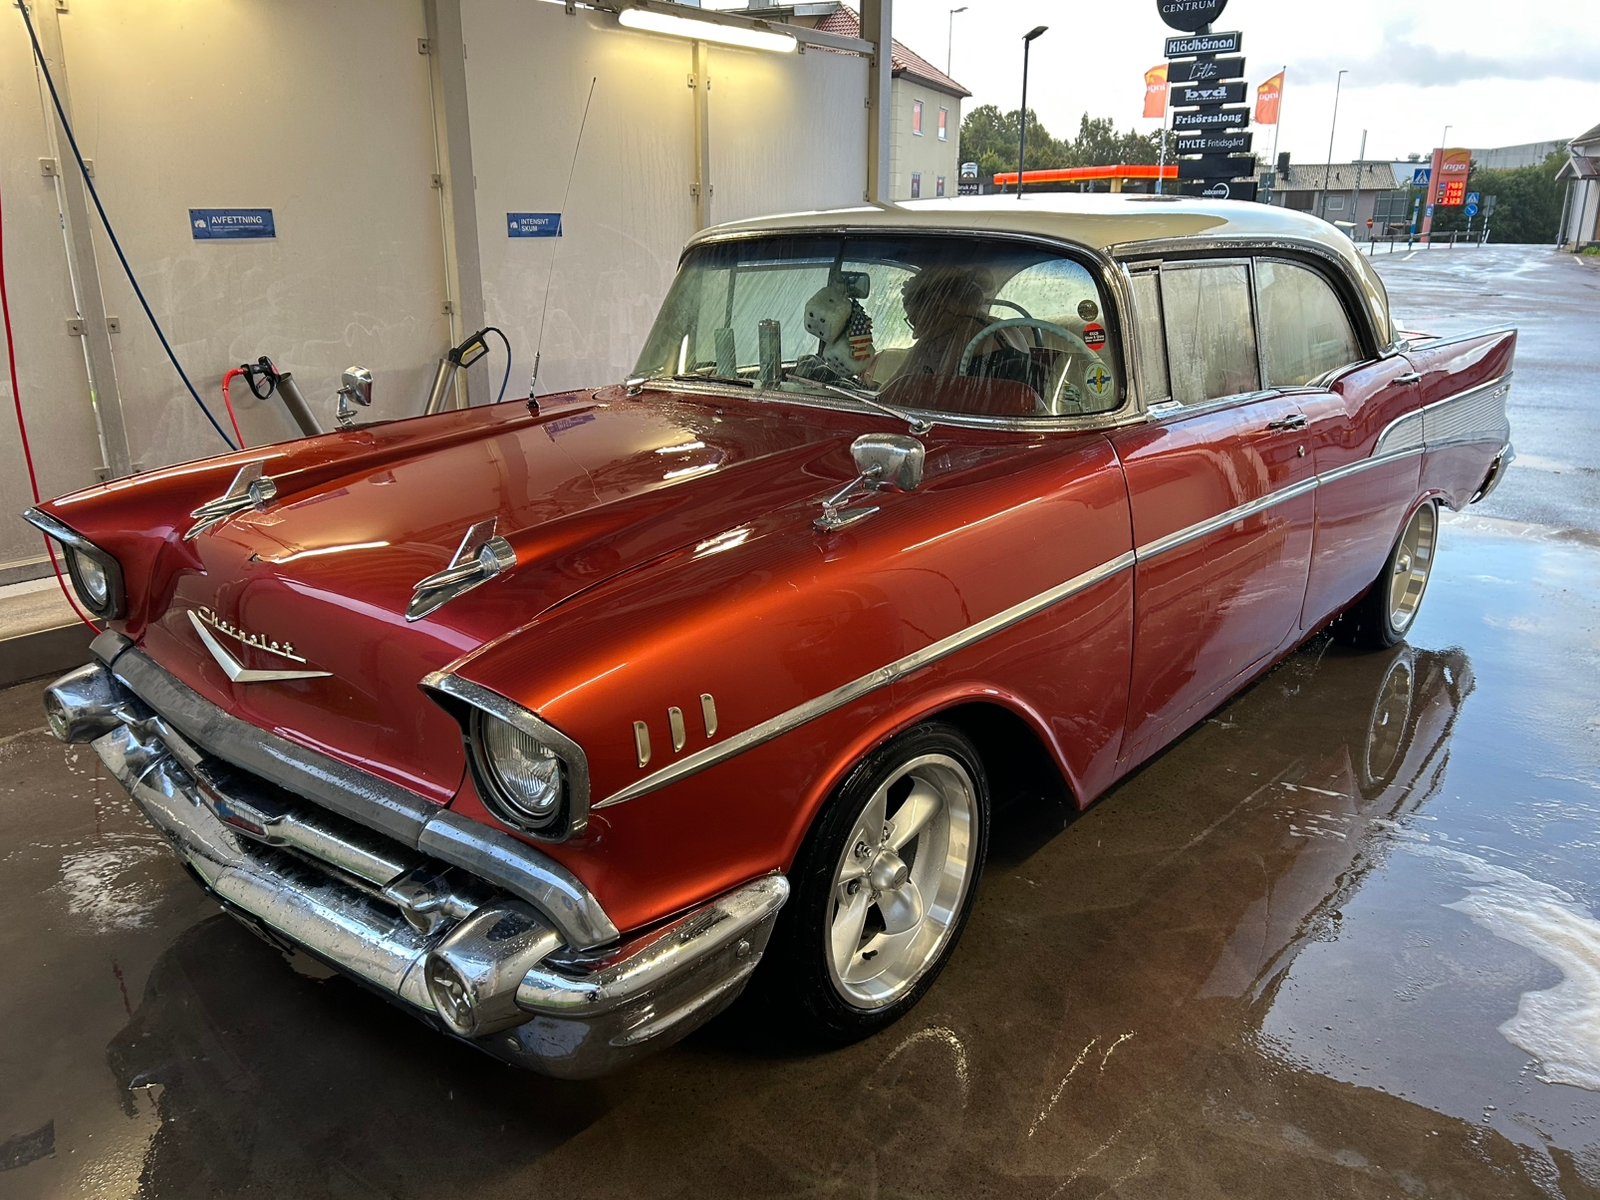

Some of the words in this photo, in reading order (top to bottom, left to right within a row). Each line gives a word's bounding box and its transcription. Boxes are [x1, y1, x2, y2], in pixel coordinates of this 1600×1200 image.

[1162, 0, 1216, 13] CENTRUM
[1168, 38, 1234, 53] Klädhörnan
[1188, 62, 1217, 80] Lotta
[1184, 86, 1228, 98] bvd
[1175, 112, 1242, 125] Frisörsalong
[1178, 138, 1207, 149] HYLTE
[1207, 137, 1245, 149] Fritidsgård
[1442, 163, 1466, 172] ingo
[211, 215, 263, 224] AVFETTNING
[198, 606, 306, 663] Chevrolet
